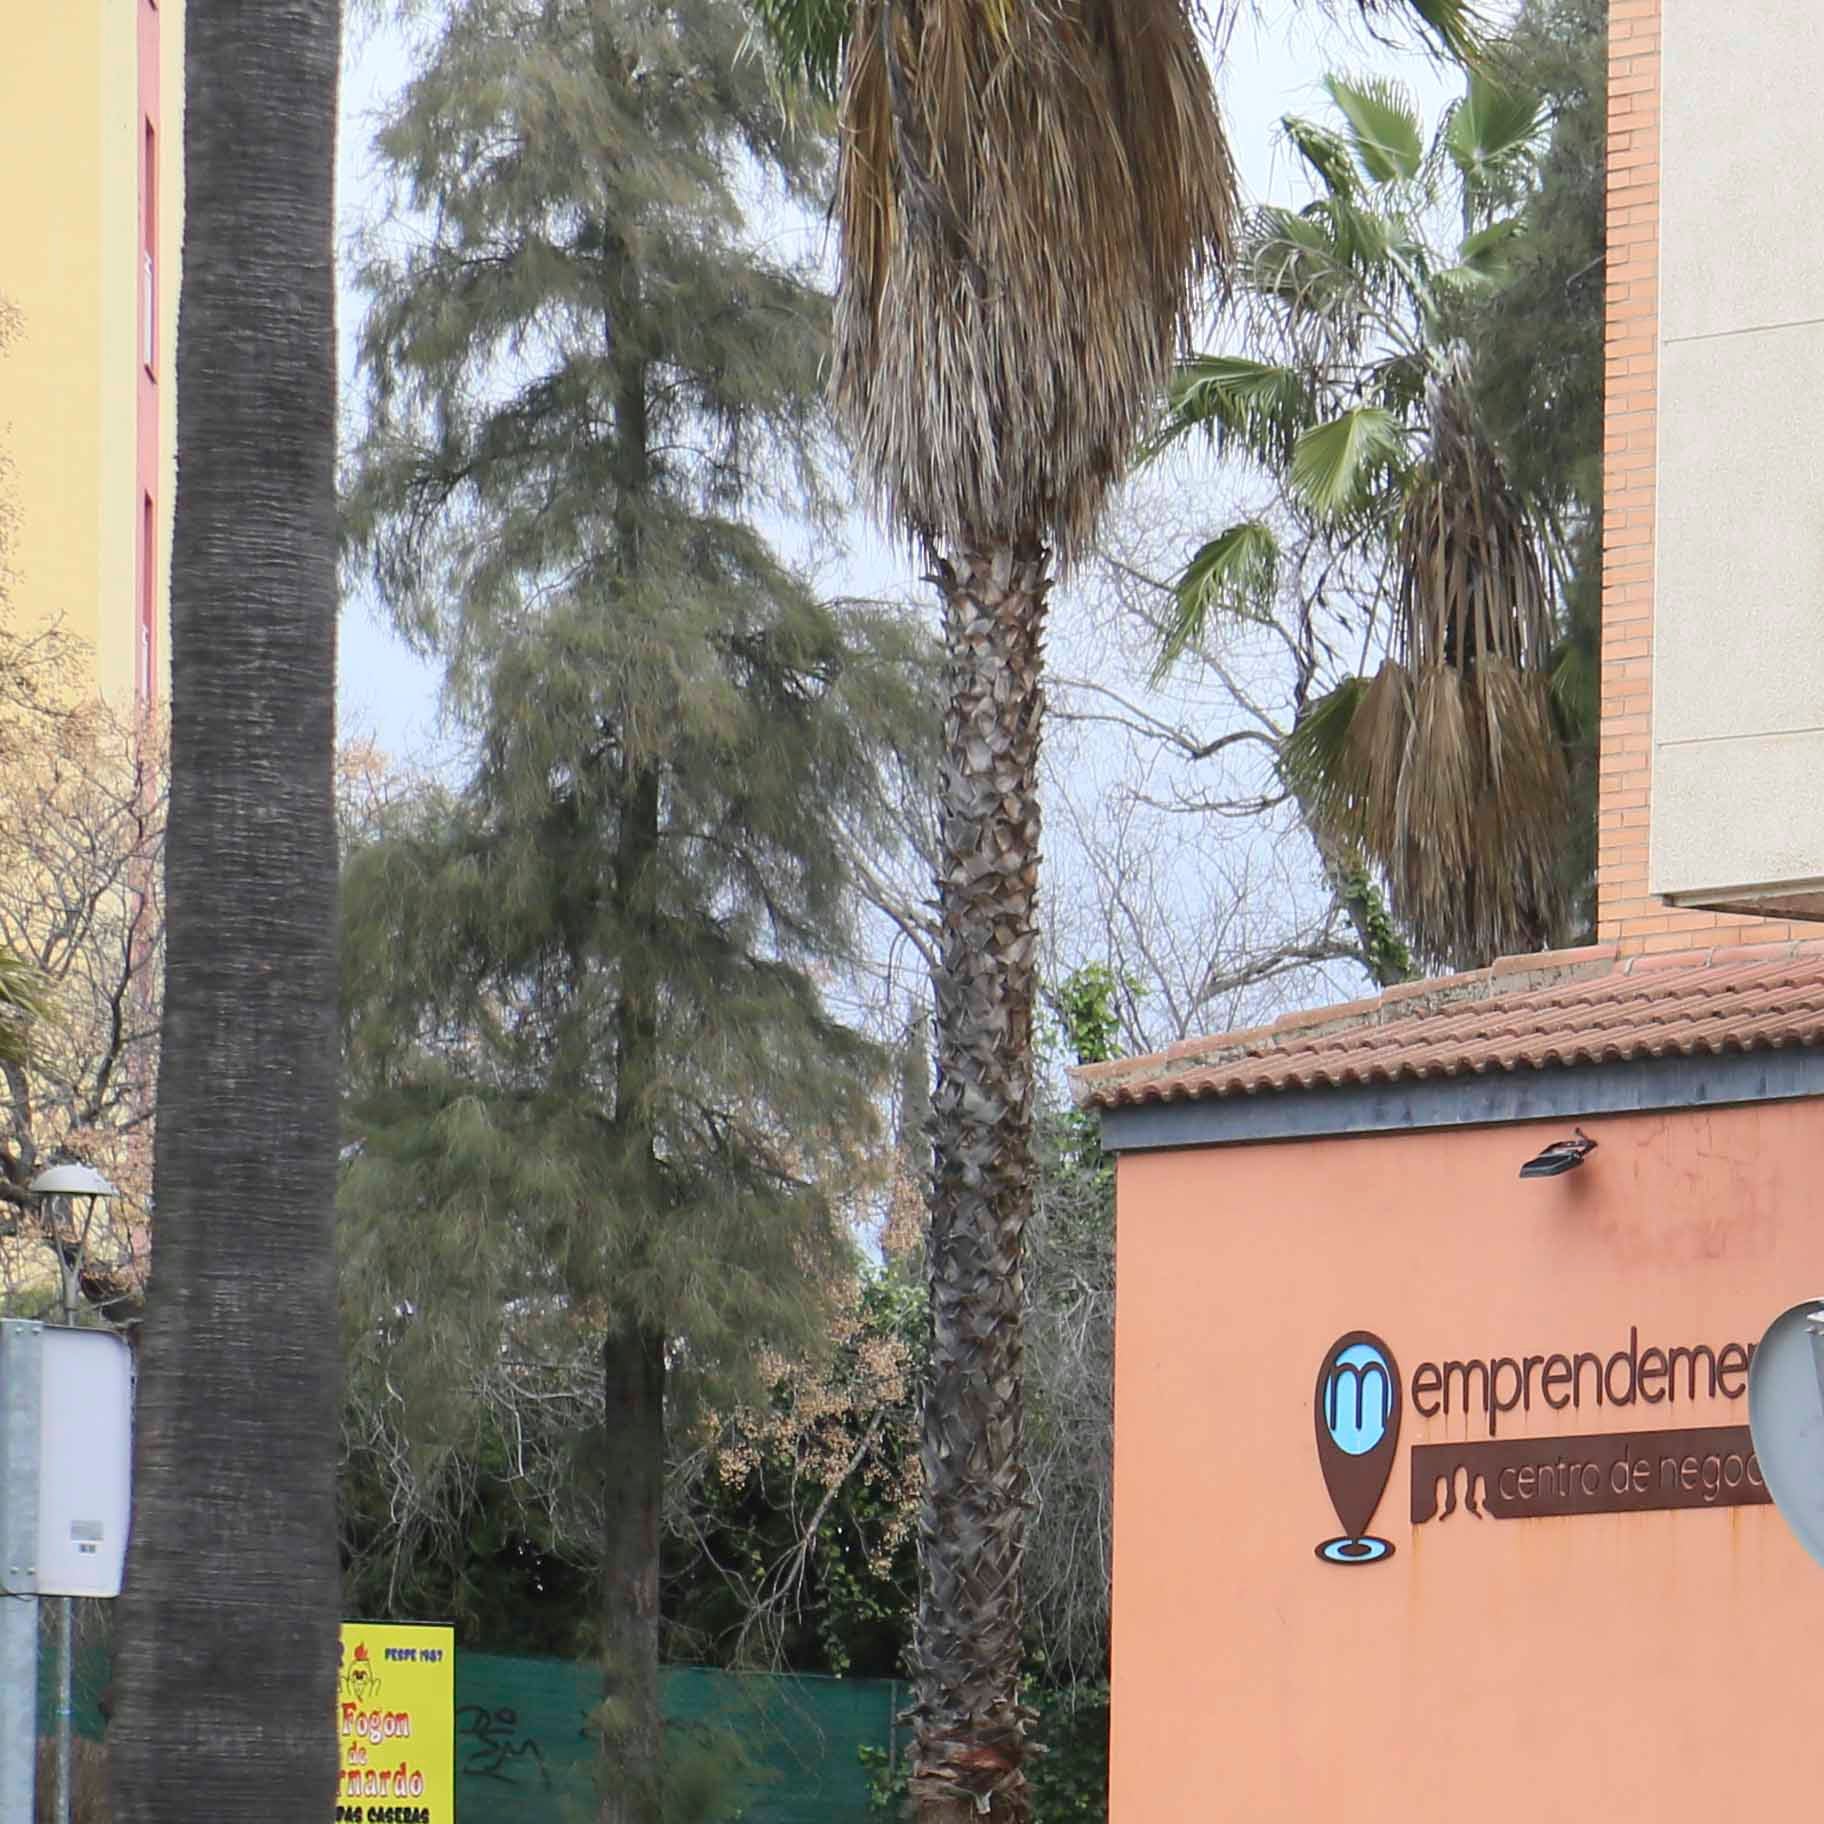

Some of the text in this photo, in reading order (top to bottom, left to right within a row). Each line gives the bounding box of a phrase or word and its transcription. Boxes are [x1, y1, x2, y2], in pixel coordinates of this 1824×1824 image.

[1411, 1325, 1758, 1436] emprendeme
[1498, 1443, 1763, 1502] centro de negoc
[341, 1702, 410, 1745] Fogon
[347, 1740, 367, 1766] de
[336, 1761, 424, 1798] rnardo
[336, 1806, 430, 1824] PAS CASERAS
